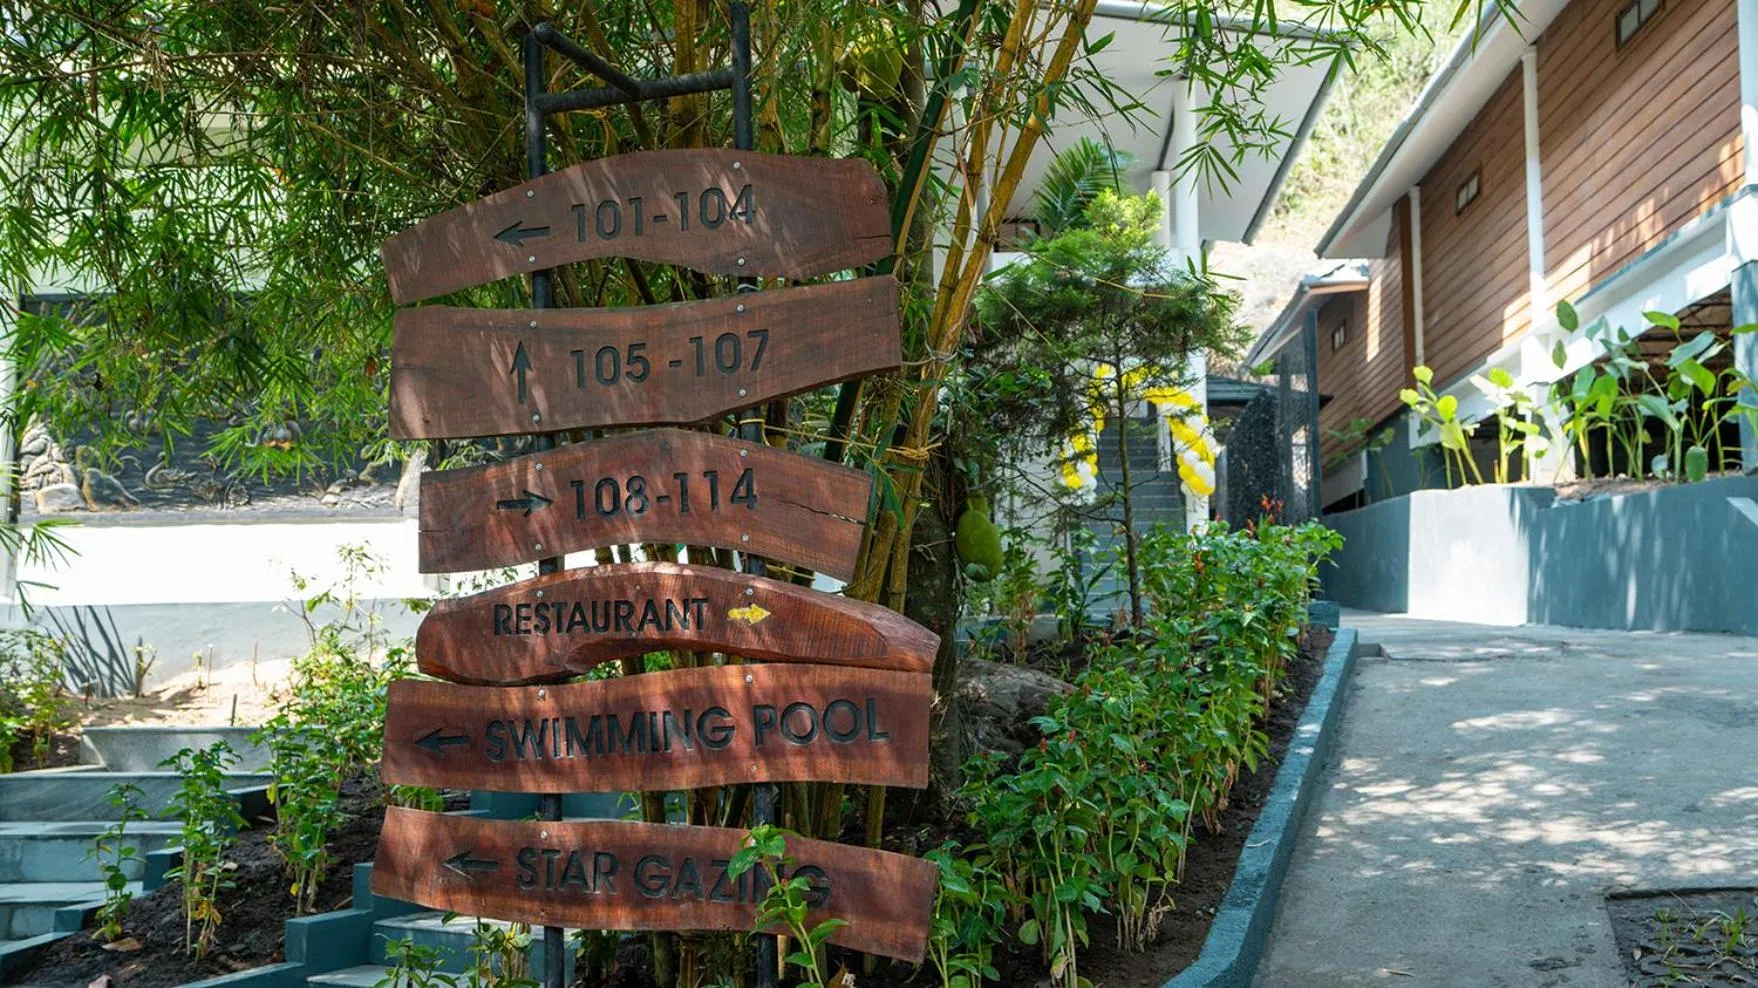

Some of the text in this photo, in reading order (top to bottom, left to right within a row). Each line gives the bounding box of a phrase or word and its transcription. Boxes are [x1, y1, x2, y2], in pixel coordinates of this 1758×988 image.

[571, 184, 756, 242] 101-104
[570, 342, 650, 389] 105
[570, 468, 758, 520] 108-114
[493, 597, 709, 636] RESTAURANT
[485, 699, 889, 763] SWIMMING POOL
[515, 846, 620, 895] STAR
